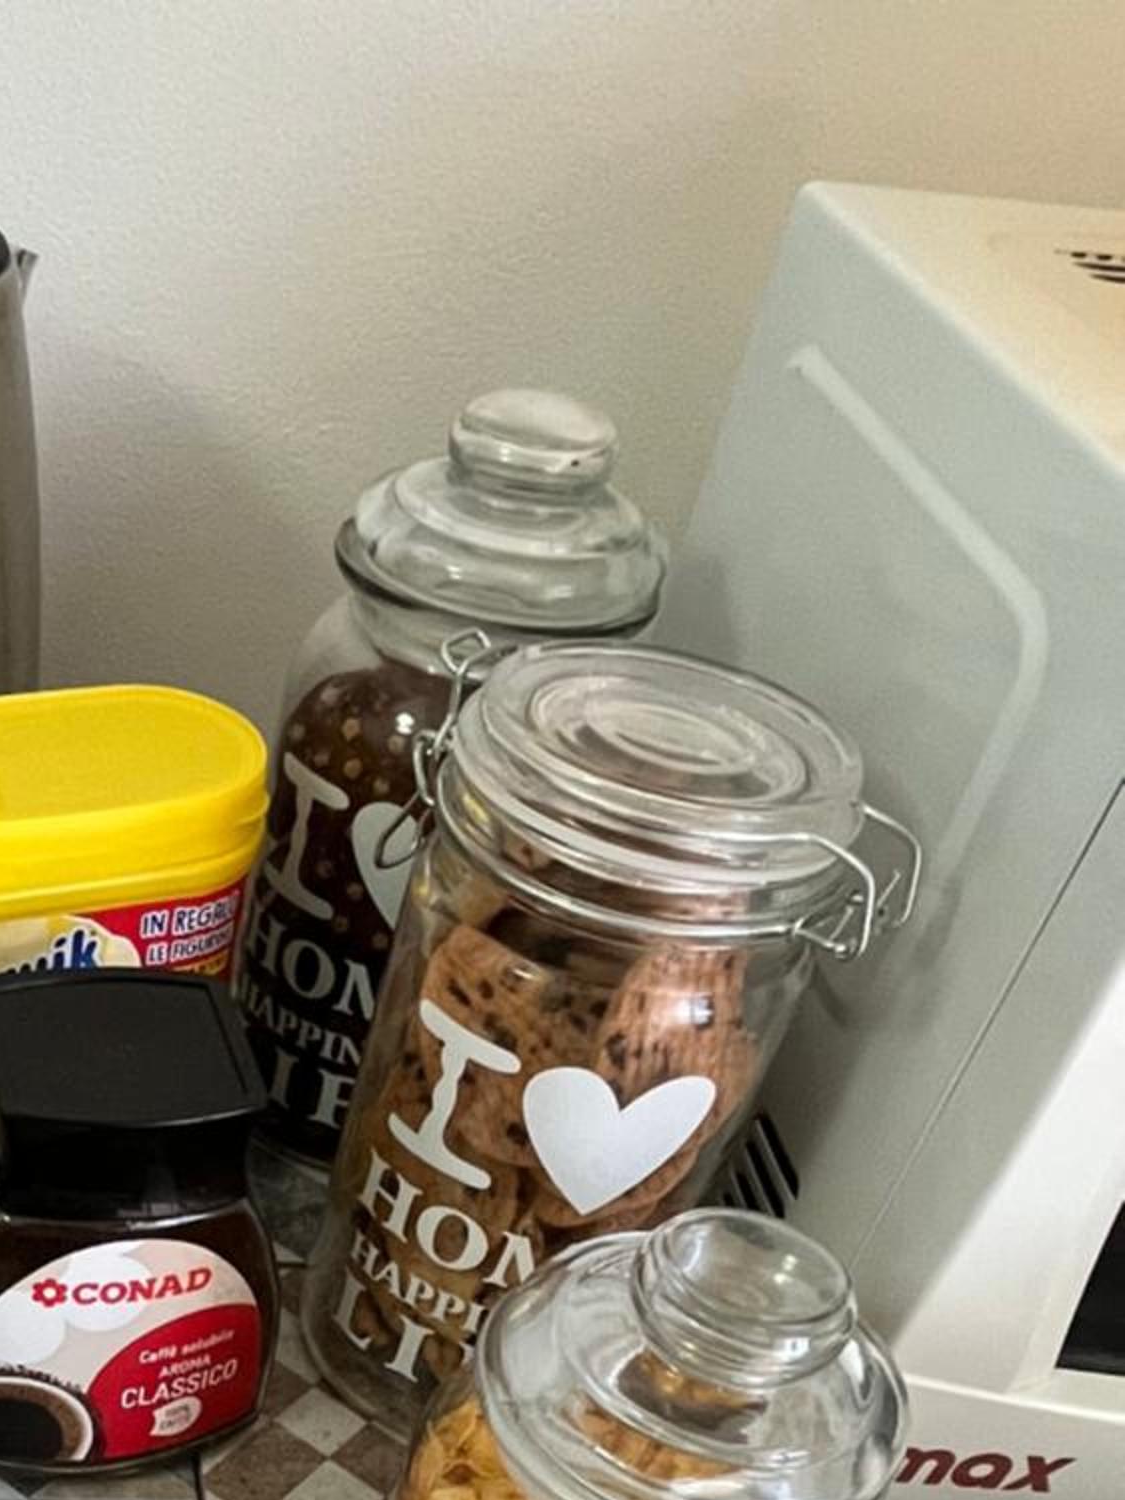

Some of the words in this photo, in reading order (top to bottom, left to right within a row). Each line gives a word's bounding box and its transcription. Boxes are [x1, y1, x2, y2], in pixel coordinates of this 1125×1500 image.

[264, 751, 350, 920] I
[142, 913, 166, 935] IN
[148, 945, 164, 962] LE
[387, 999, 521, 1190] I
[71, 1267, 213, 1305] CONAD
[120, 1359, 238, 1409] CLASSICO
[157, 1355, 212, 1379] AROMA
